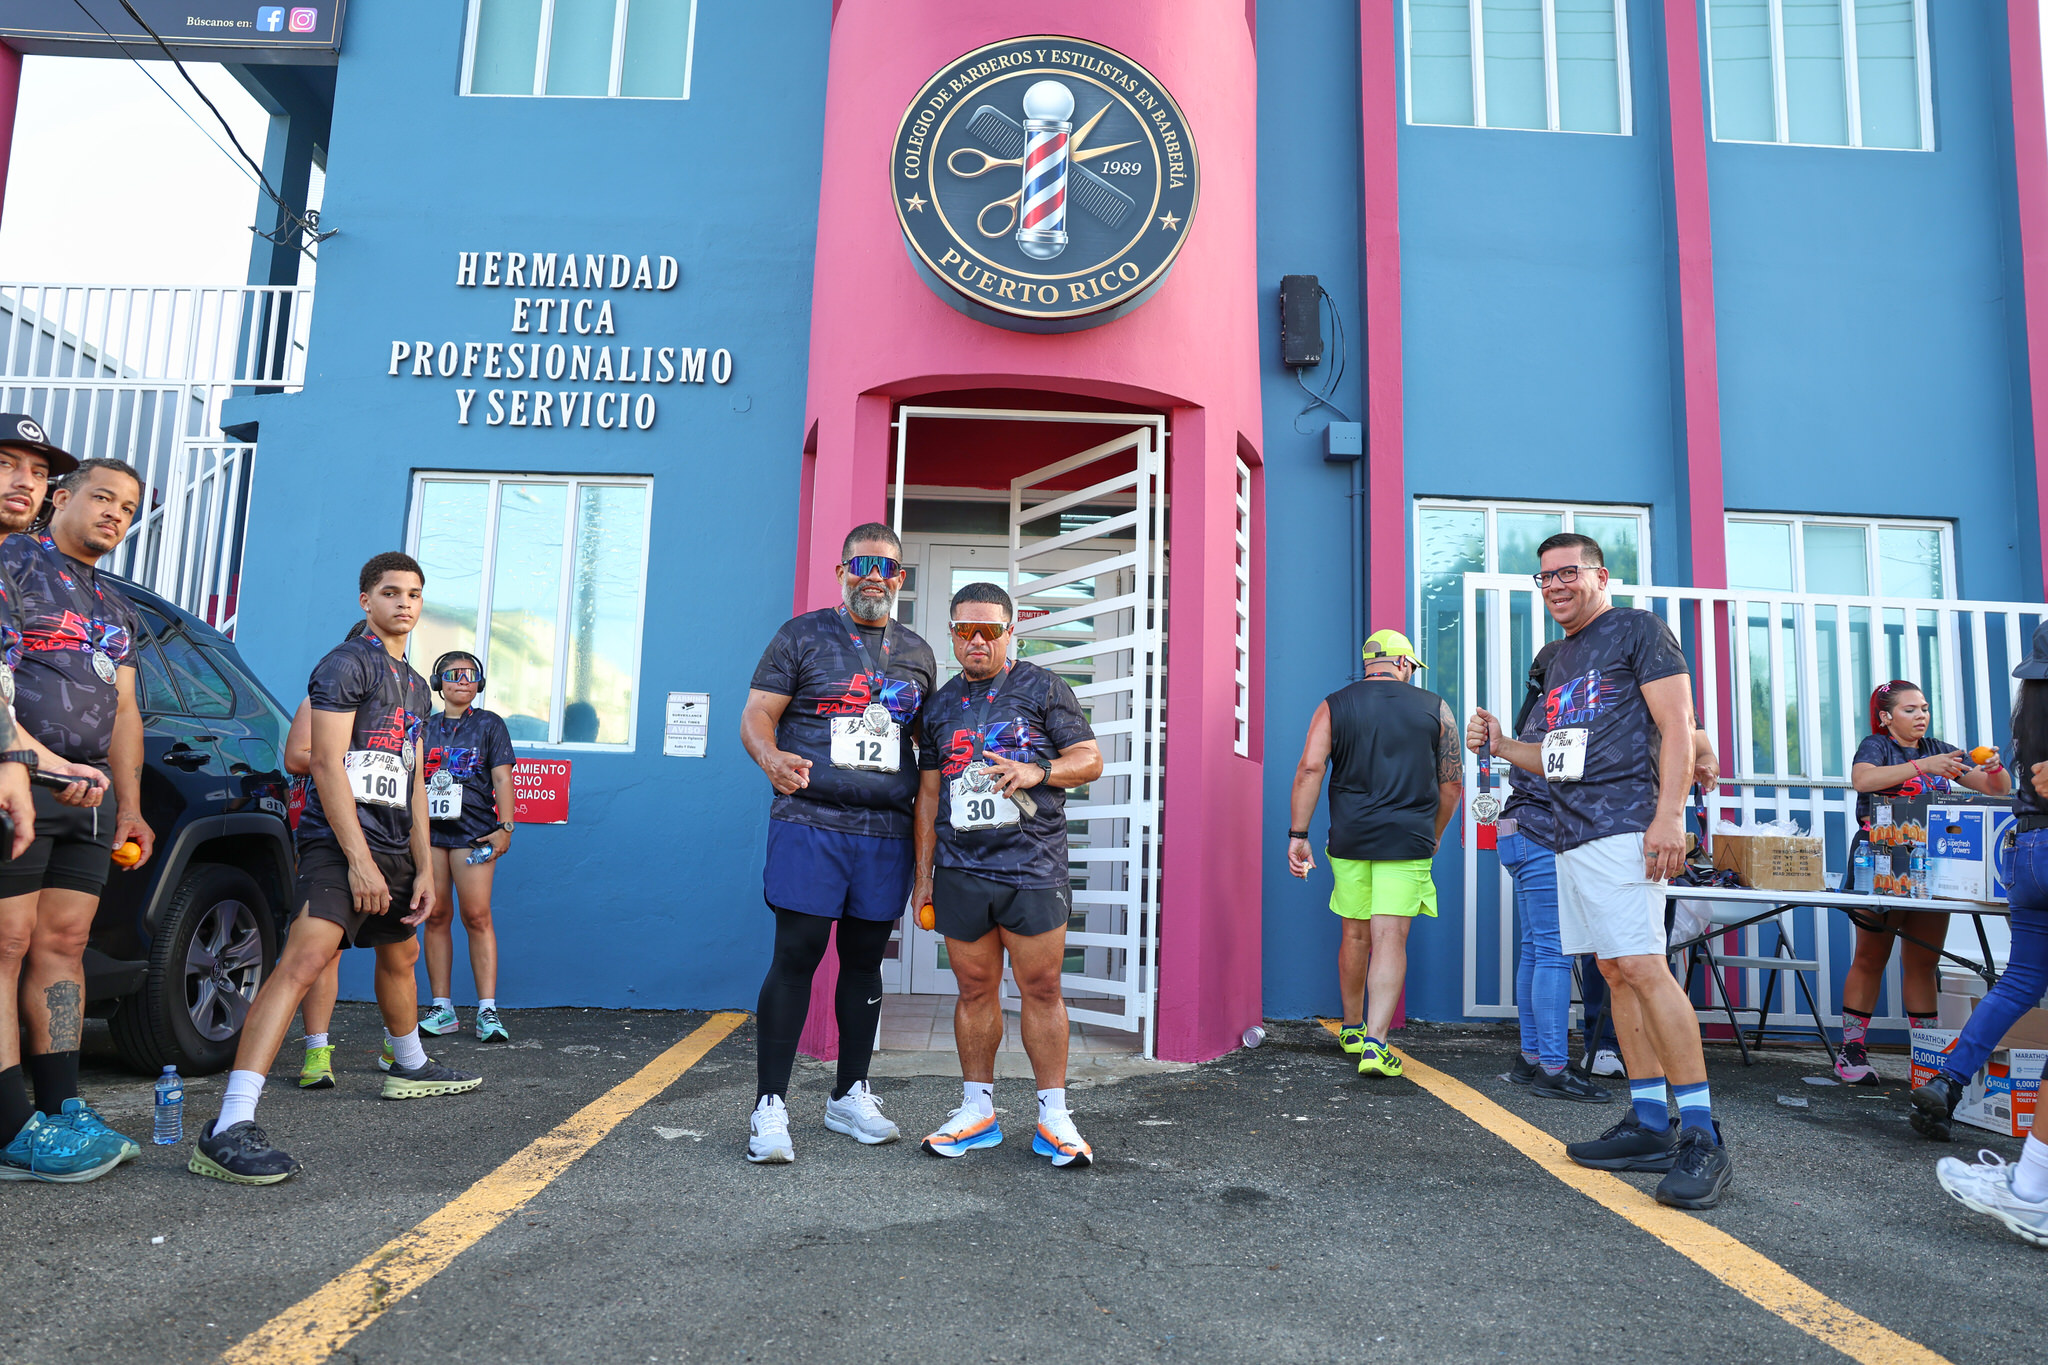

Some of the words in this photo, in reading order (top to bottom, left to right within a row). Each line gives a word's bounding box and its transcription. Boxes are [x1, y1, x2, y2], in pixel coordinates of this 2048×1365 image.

[186, 16, 234, 28] Búscanos
[236, 20, 252, 28] en:
[904, 109, 936, 179] COLEGIO
[928, 88, 953, 111] DE
[948, 50, 1033, 93] BARBEROS
[1035, 49, 1048, 63] Y
[1051, 50, 1139, 92] ESTILISTAS
[1134, 88, 1159, 110] EN
[1100, 160, 1142, 176] 1989
[455, 251, 679, 290] HERMANDAD
[938, 247, 1059, 305] PUERTO
[1067, 262, 1140, 303] RICO
[511, 297, 616, 336] ETICA
[387, 340, 734, 385] PROFESIONALISMO
[455, 389, 477, 425] Y
[486, 389, 657, 430] SERVICIO
[1553, 730, 1568, 741] FADE
[855, 740, 882, 762] 12
[1559, 739, 1573, 748] RUN
[374, 753, 394, 765] FADE
[1547, 752, 1565, 773] 84
[384, 763, 399, 773] RUN
[512, 763, 566, 776] AMIENTO
[362, 773, 397, 799] 160
[512, 775, 542, 787] SIVO
[514, 788, 556, 800] GIADOS
[966, 798, 996, 822] 30
[1912, 1031, 1947, 1045] MARATHON
[1914, 1050, 1936, 1065] 6,000
[1986, 1076, 1993, 1088] 6
[1993, 1079, 2010, 1090] ROLLS
[2015, 1080, 2035, 1089] 6,000
